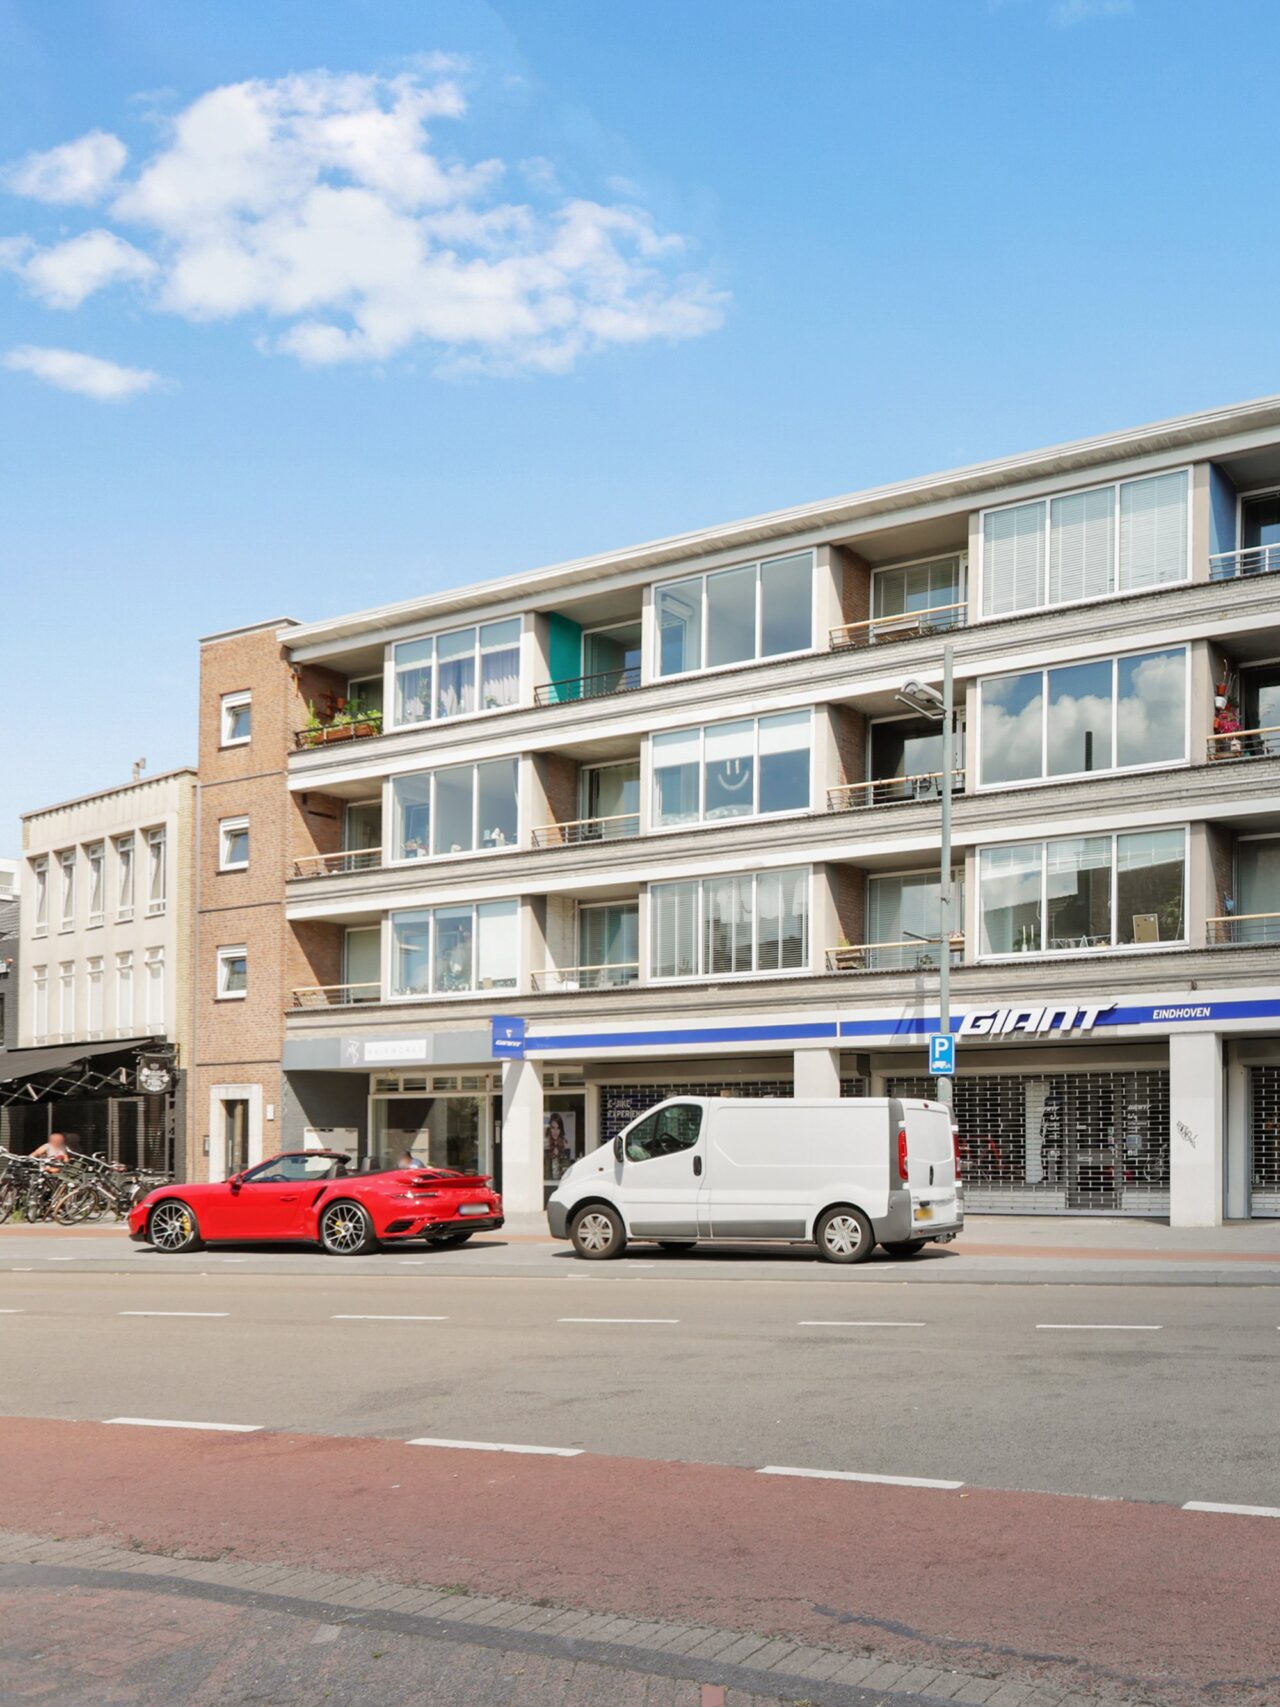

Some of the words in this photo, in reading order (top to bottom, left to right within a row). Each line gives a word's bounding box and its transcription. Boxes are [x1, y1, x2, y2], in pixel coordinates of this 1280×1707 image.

[958, 1002, 1119, 1036] GIANT
[1152, 1006, 1211, 1020] EINDHOVEN
[935, 1038, 950, 1058] P
